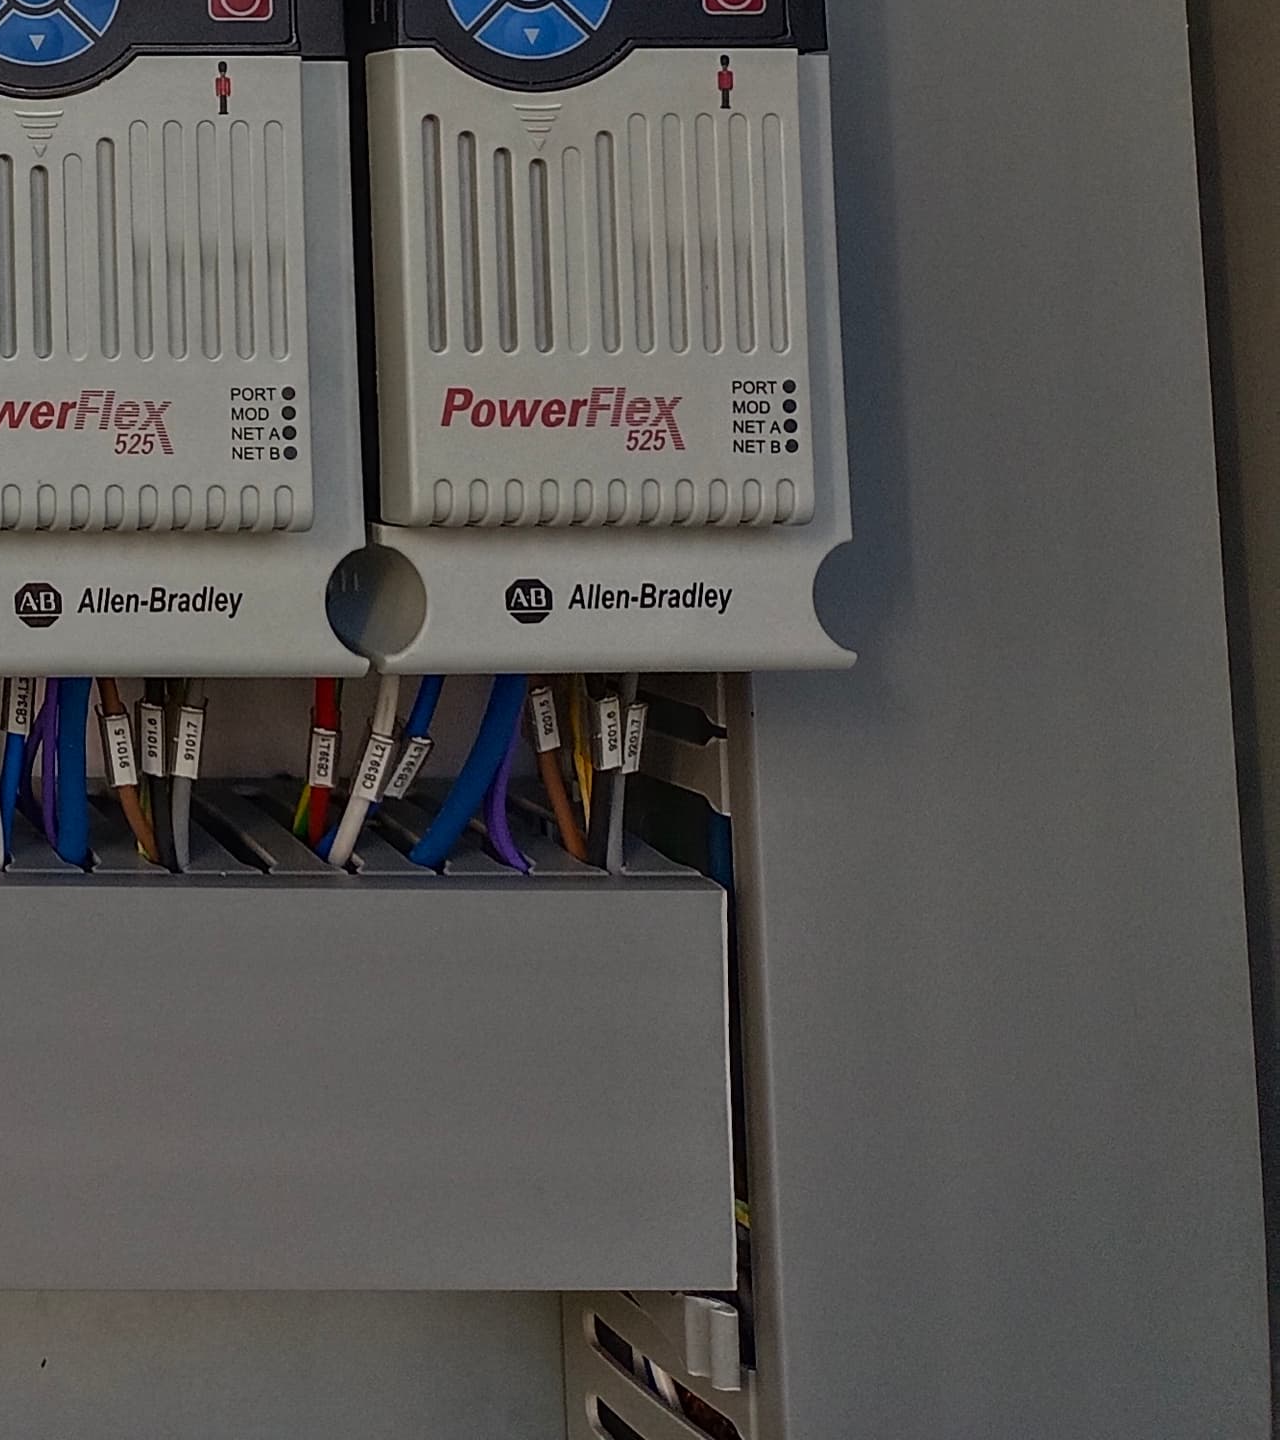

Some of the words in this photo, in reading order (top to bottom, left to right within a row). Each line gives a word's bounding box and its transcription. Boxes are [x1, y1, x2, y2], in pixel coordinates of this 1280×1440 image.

[230, 387, 276, 401] PORT
[731, 380, 778, 395] PORT
[230, 407, 270, 421] MOD
[732, 400, 771, 414] MOD
[440, 386, 686, 452] PowerFlex
[732, 420, 767, 434] NET
[769, 420, 782, 434] A
[231, 426, 266, 441] NET
[268, 426, 281, 441] A
[625, 429, 667, 452] 525
[114, 433, 155, 455] 525
[231, 446, 267, 460] NET
[269, 446, 281, 460] B
[732, 440, 768, 454] NET
[770, 440, 781, 453] B
[77, 586, 243, 619] Allen-Bradley
[568, 582, 733, 614] Allen-Bradley
[114, 727, 130, 769] 9101.5
[183, 721, 198, 761] 9101.7
[362, 744, 386, 790] CB39.L2
